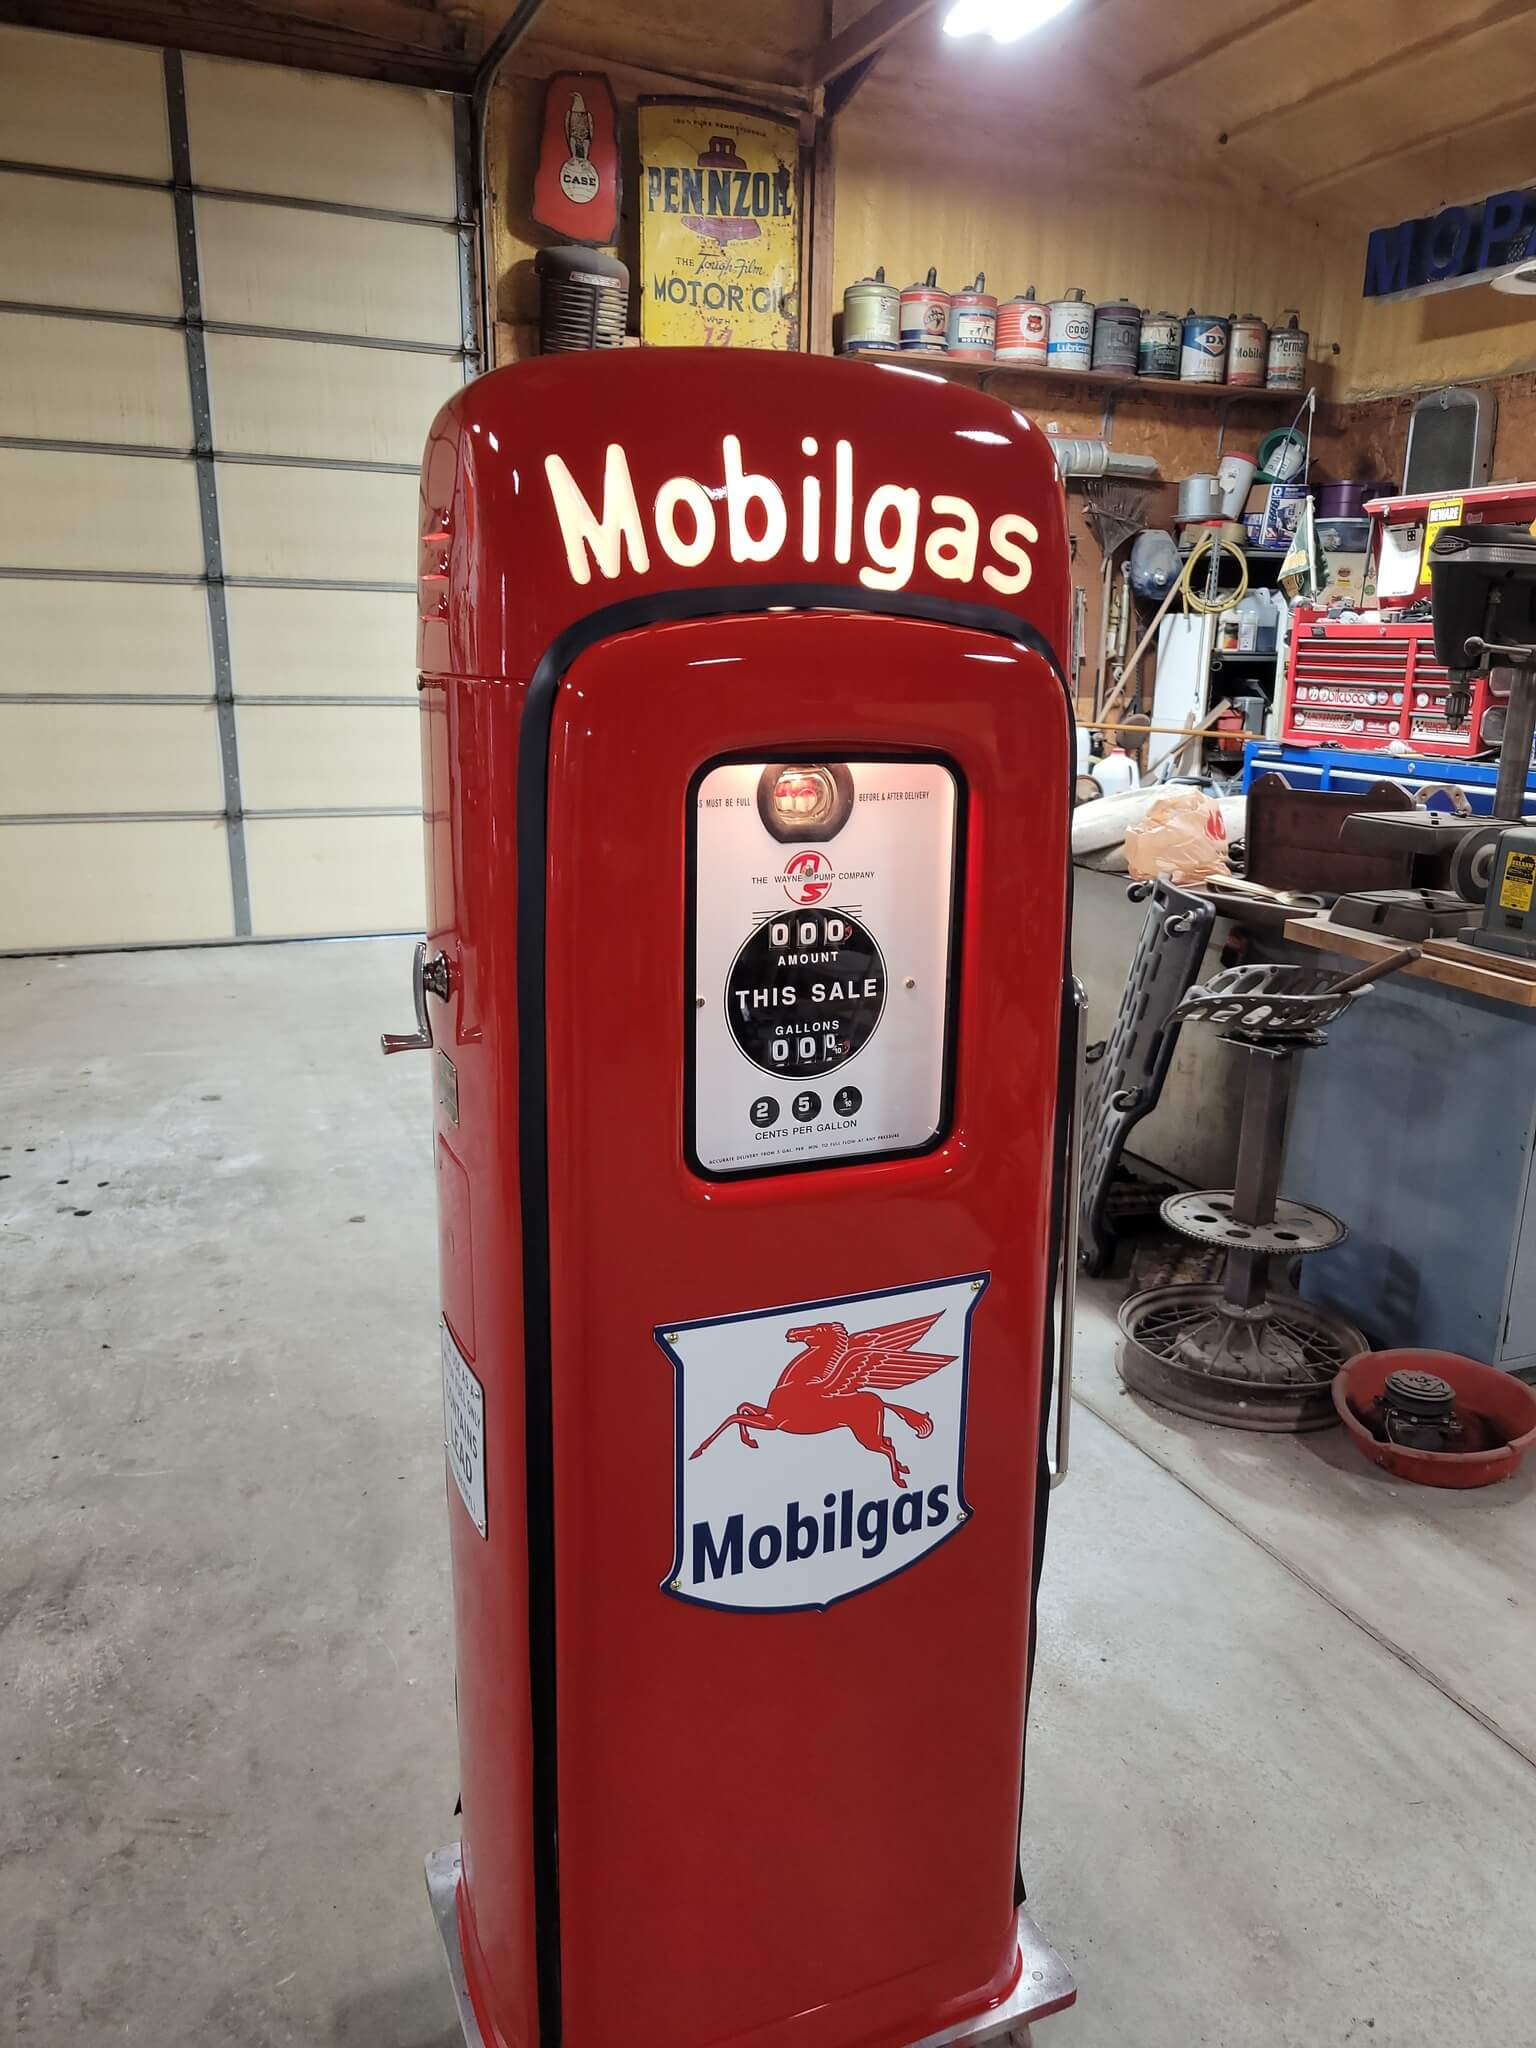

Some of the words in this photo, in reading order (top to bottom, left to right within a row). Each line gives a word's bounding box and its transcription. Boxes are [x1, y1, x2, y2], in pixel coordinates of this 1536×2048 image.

[563, 174, 596, 186] CASE
[1364, 188, 1536, 297] MOP
[676, 257, 695, 267] THE
[654, 273, 744, 312] MOTOR
[1206, 335, 1224, 345] DX
[544, 434, 1039, 595] Mobilgas
[1430, 506, 1460, 522] BEWARE
[706, 799, 722, 808] MUST
[725, 798, 734, 807] BE
[736, 797, 751, 807] FULL
[859, 792, 880, 802] BEFORE
[887, 792, 904, 801] AFTER
[905, 790, 930, 800] DELIVERY
[752, 877, 768, 885] THE
[774, 873, 804, 884] WAYNE
[814, 872, 836, 882] PUMP
[838, 871, 876, 880] COMPANY
[777, 951, 839, 967] AMOUNT
[735, 985, 796, 1009] THIS
[811, 978, 877, 1003] SALE
[775, 1020, 840, 1035] GALLONS
[756, 1101, 769, 1118] 2
[798, 1096, 810, 1112] 5
[755, 1128, 789, 1141] CENTS
[792, 1124, 813, 1136] PER
[816, 1118, 858, 1133] GALLON
[709, 1157, 734, 1165] ACCURATE
[736, 1153, 759, 1161] DELIVERY
[446, 1379, 477, 1459] CONTAINS
[451, 1416, 472, 1484] LEAD
[692, 1484, 949, 1585] Mobilgas
